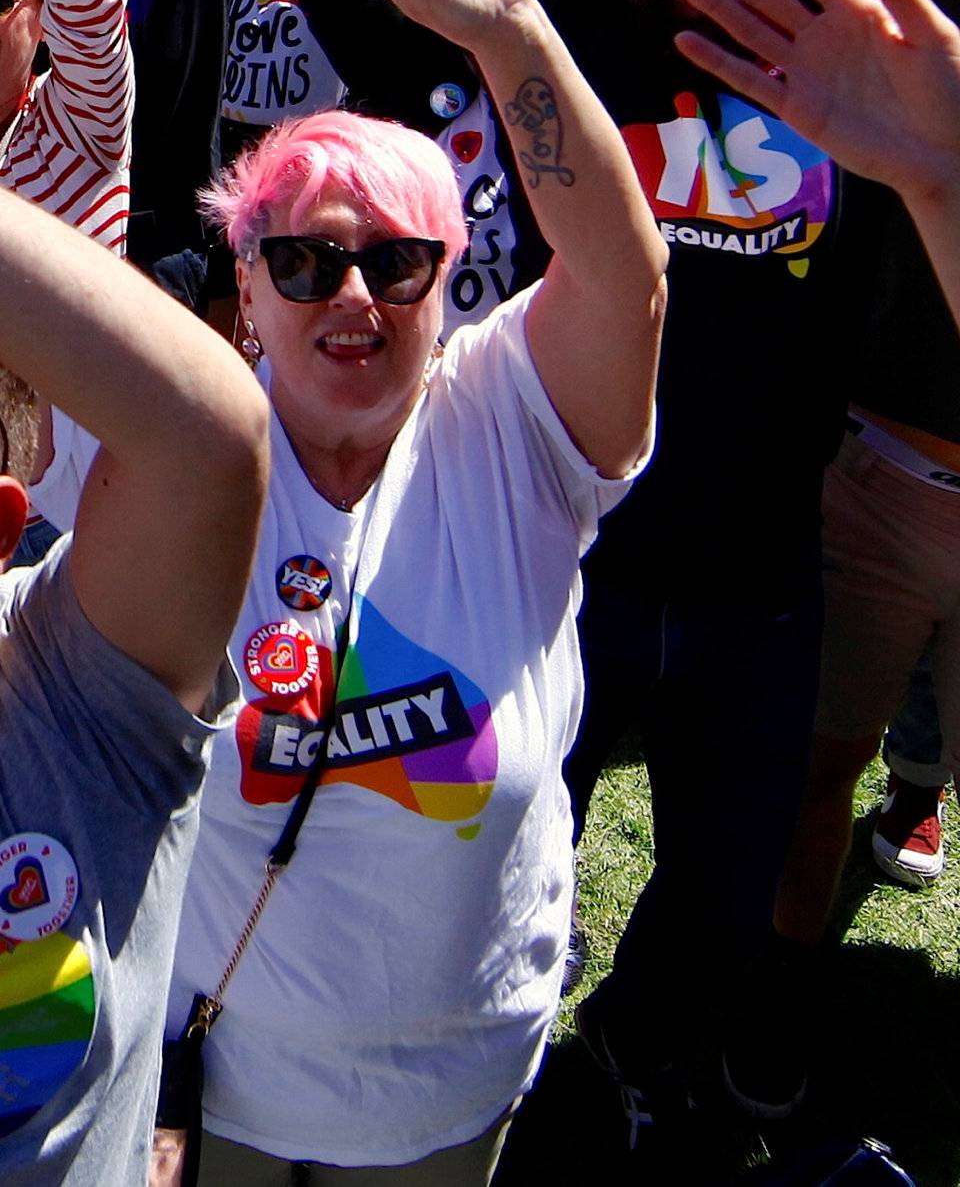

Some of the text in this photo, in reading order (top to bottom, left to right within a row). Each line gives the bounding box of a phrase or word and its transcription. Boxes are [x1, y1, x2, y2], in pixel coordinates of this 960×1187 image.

[659, 216, 803, 255] EQUALITY
[281, 564, 331, 596] YES!
[247, 622, 299, 677] STRONGER
[271, 644, 320, 695] TOGETHER
[37, 875, 76, 937] TOGETHER
